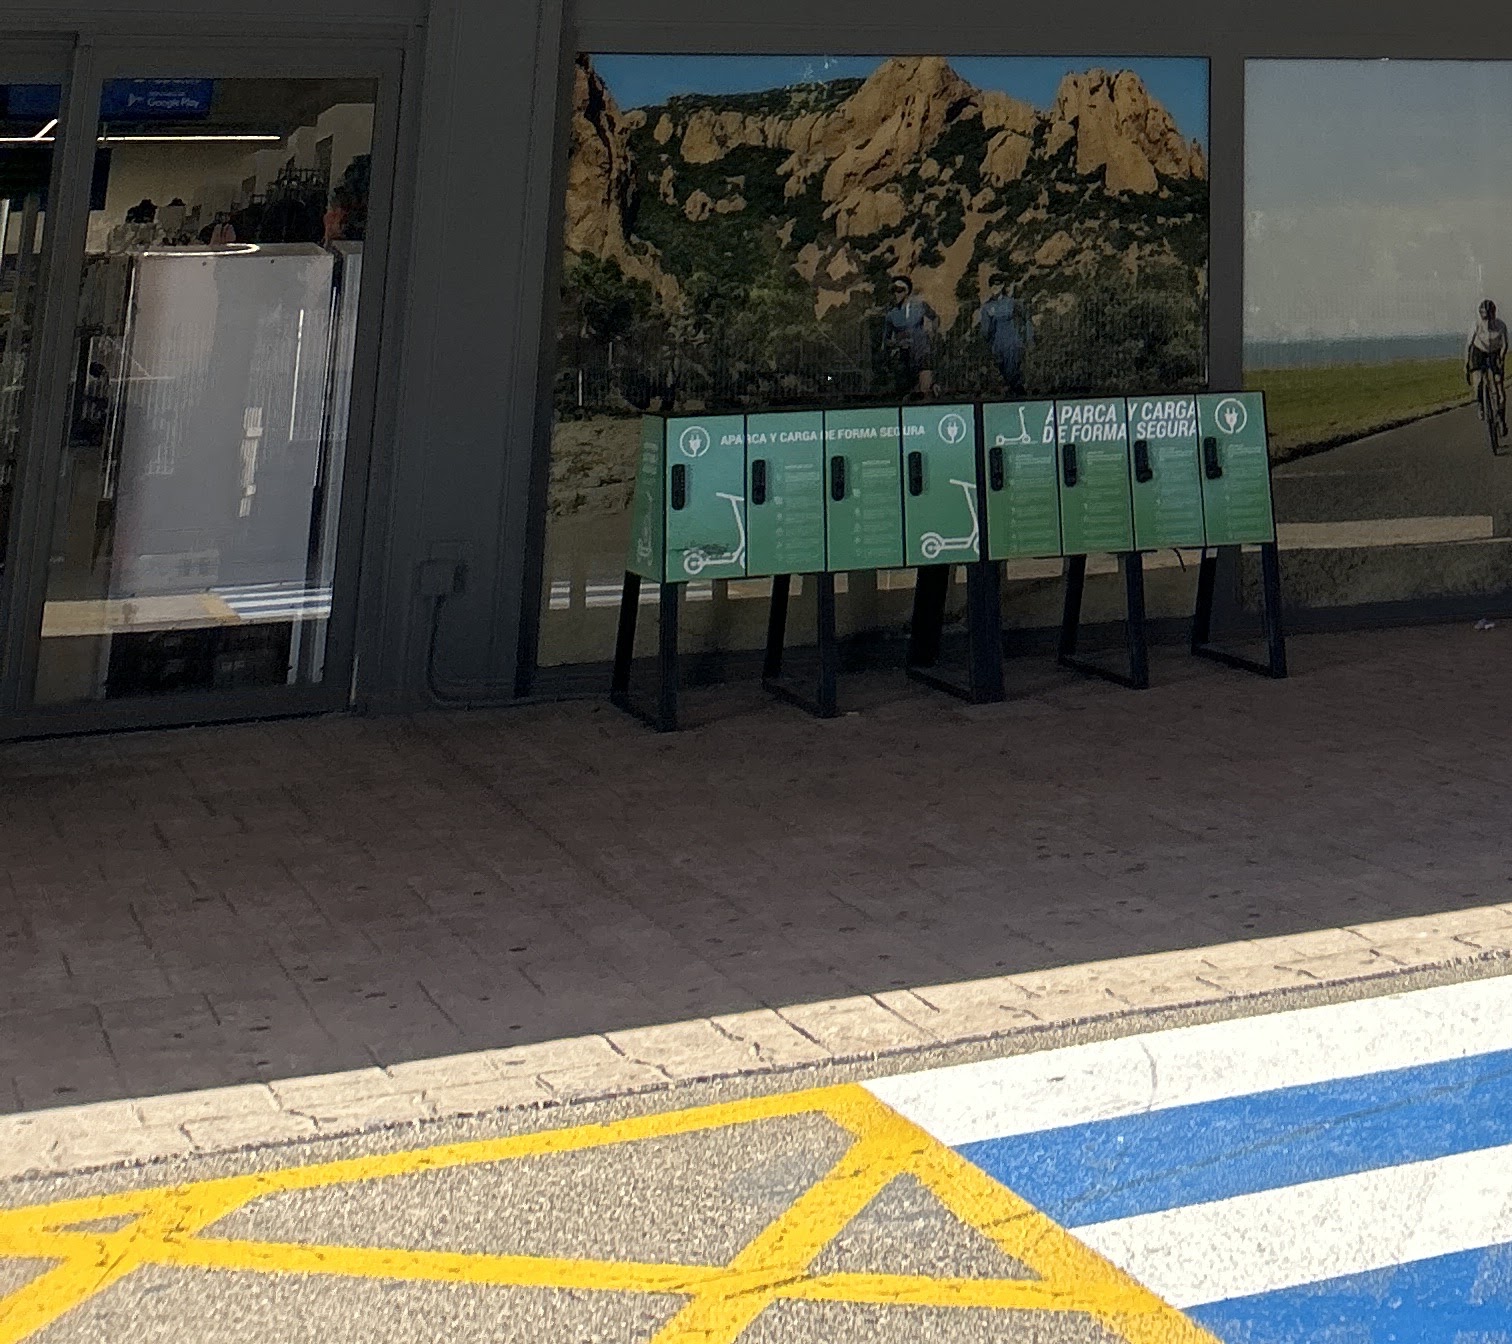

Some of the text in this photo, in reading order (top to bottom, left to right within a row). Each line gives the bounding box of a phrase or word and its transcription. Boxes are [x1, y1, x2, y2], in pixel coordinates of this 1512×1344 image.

[1045, 400, 1201, 425] APARCA Y CARGA
[721, 424, 926, 445] APARCA Y CARGA DE FORMA SEGURA
[1042, 419, 1202, 444] DE FORMA SEGURA
